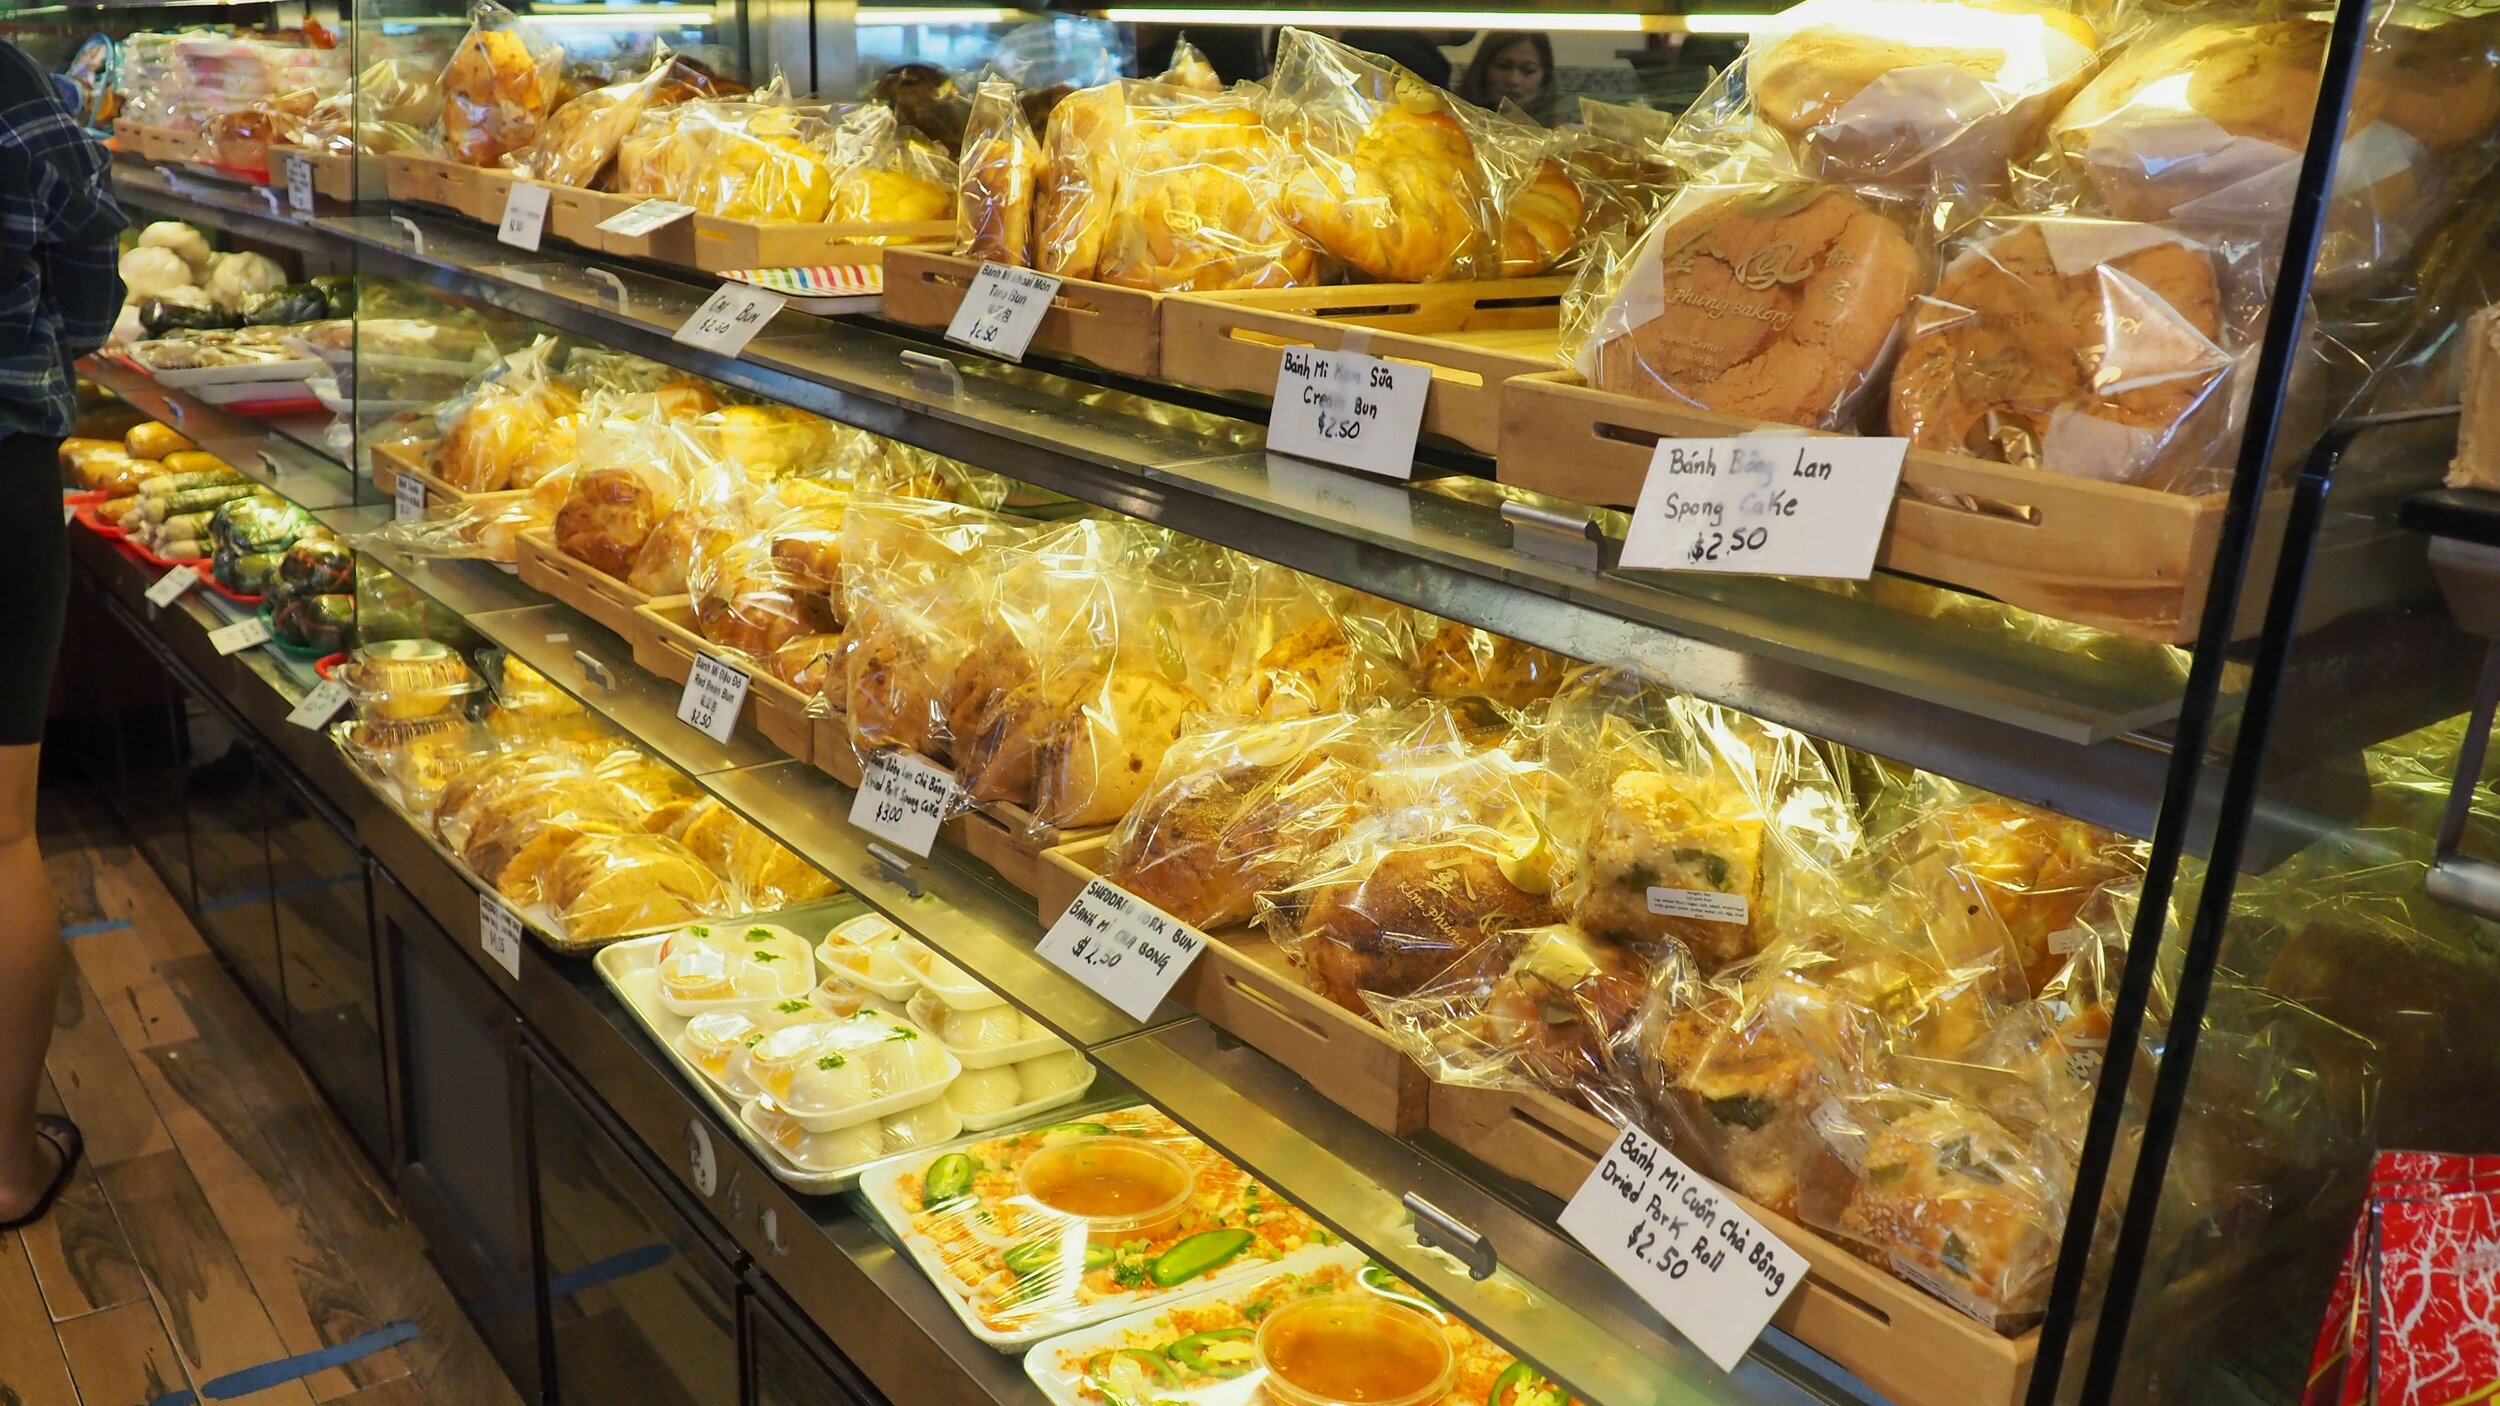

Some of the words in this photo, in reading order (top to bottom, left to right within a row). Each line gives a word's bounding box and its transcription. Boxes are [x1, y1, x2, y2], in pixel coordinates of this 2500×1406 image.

[1284, 352, 1310, 380] Bánh
[1354, 396, 1377, 419] Bun
[1318, 411, 1360, 439] $2.50
[1670, 447, 1716, 476] Bánh
[1793, 447, 1832, 480] Lan
[1664, 492, 1724, 527] Spong
[1688, 527, 1768, 564] $2.50
[721, 688, 734, 703] Bun
[691, 708, 711, 729] $2.50
[875, 801, 902, 824] $3.00
[1172, 928, 1198, 954] BUN
[1138, 942, 1171, 976] BONG
[1601, 1160, 1646, 1204] Dried
[1691, 1236, 1725, 1273] Roll
[1620, 1132, 1658, 1177] Bánh
[1748, 1242, 1785, 1297] Bông
[1627, 1220, 1689, 1279] $2.50
